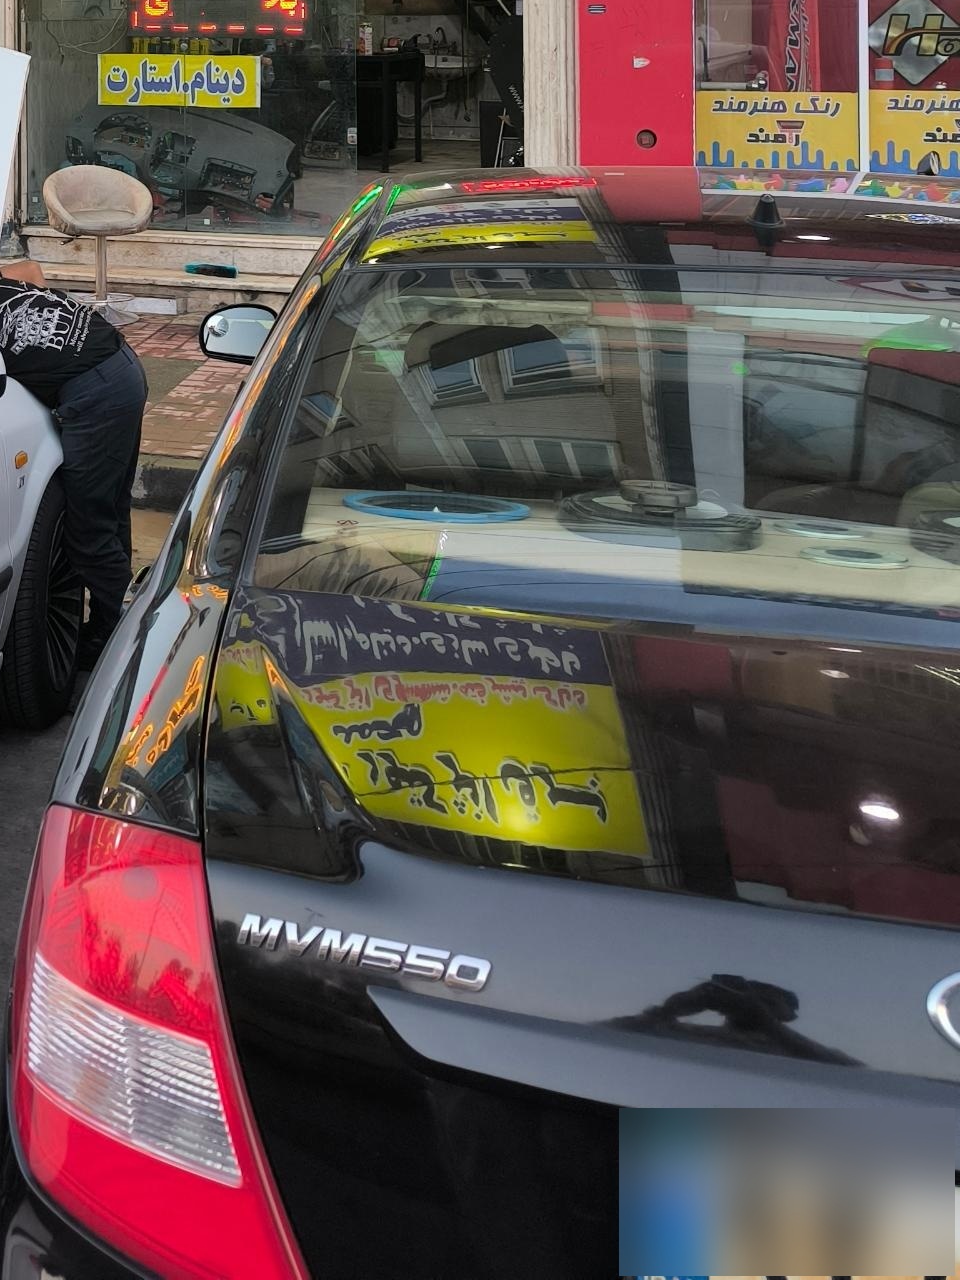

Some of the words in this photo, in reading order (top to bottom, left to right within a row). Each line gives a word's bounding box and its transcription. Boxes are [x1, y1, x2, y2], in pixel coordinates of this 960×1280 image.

[105, 60, 181, 103] استارت
[711, 95, 789, 117] هنرمند
[794, 96, 842, 119] رنگ
